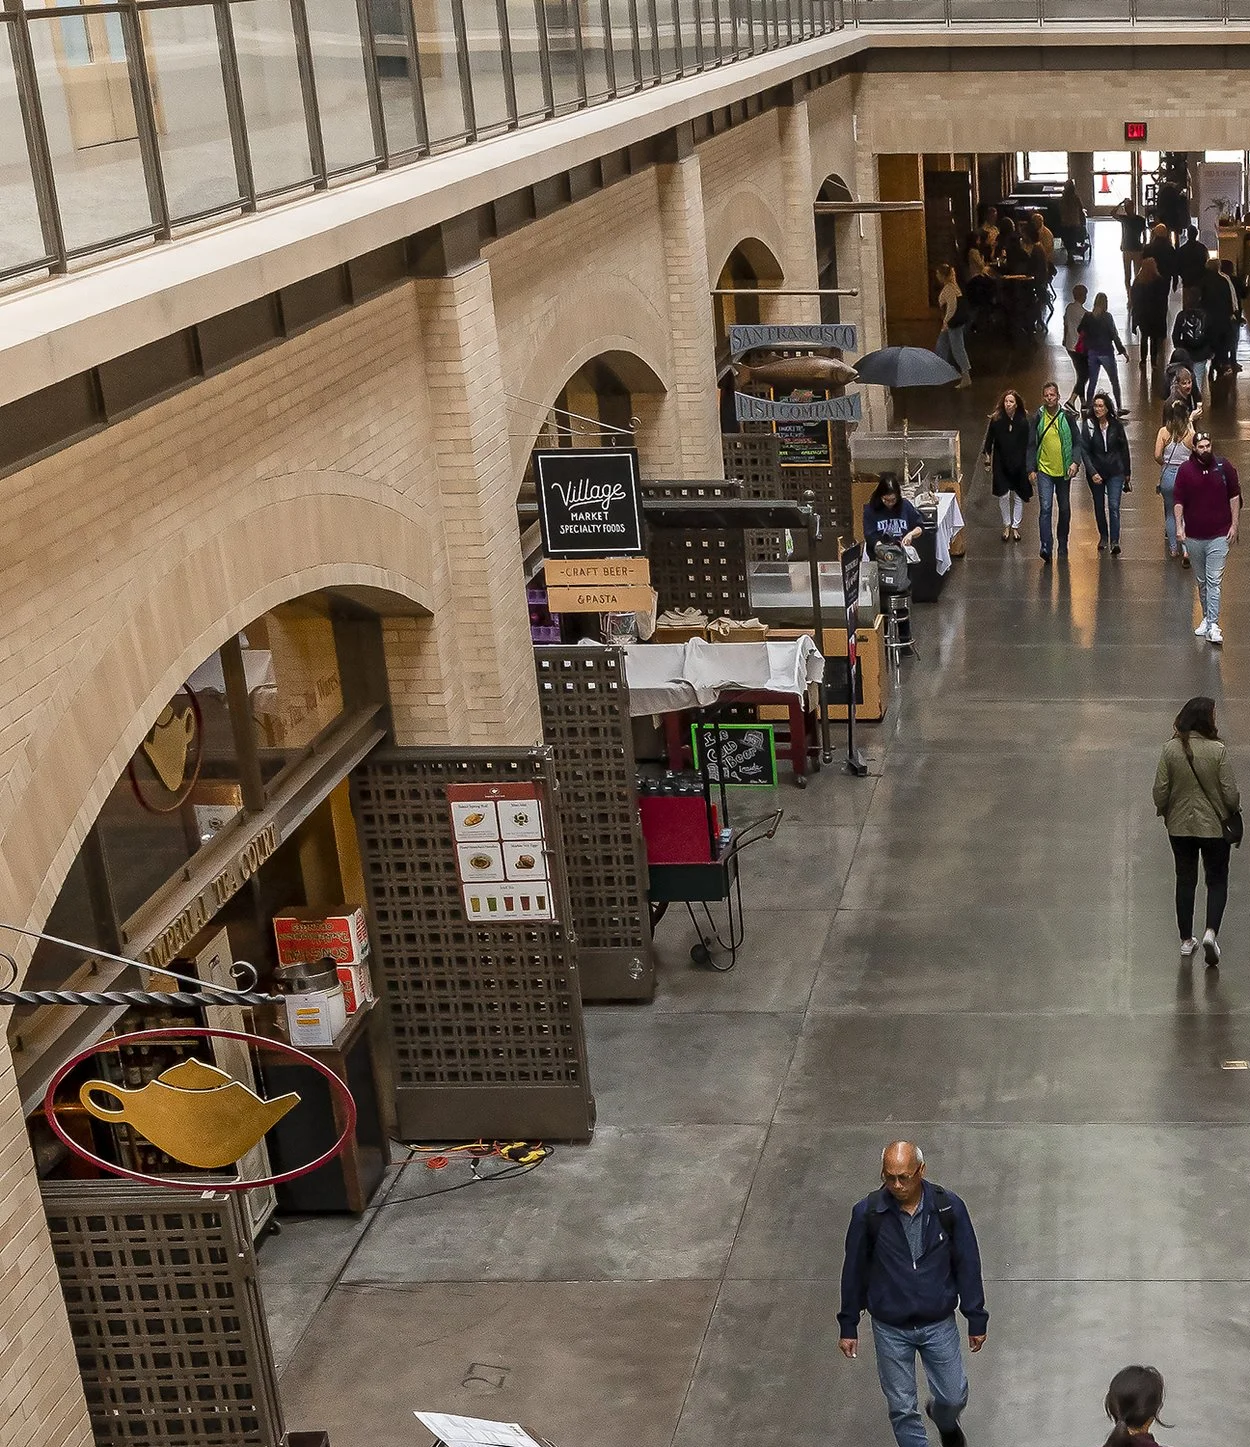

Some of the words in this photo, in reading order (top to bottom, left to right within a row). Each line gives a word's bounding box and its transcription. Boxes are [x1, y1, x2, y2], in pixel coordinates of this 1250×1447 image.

[732, 327, 767, 354] SAN
[768, 326, 856, 349] FRANCISCO
[739, 397, 775, 418] FISH
[780, 397, 857, 418] COMPANY
[551, 478, 627, 511] Village
[570, 511, 609, 522] MARKET
[559, 524, 601, 535] SPECIALTY
[602, 523, 626, 534] FOODS
[144, 892, 211, 967] IMPERIAL
[211, 869, 238, 909] TEA
[240, 821, 277, 880] COURT
